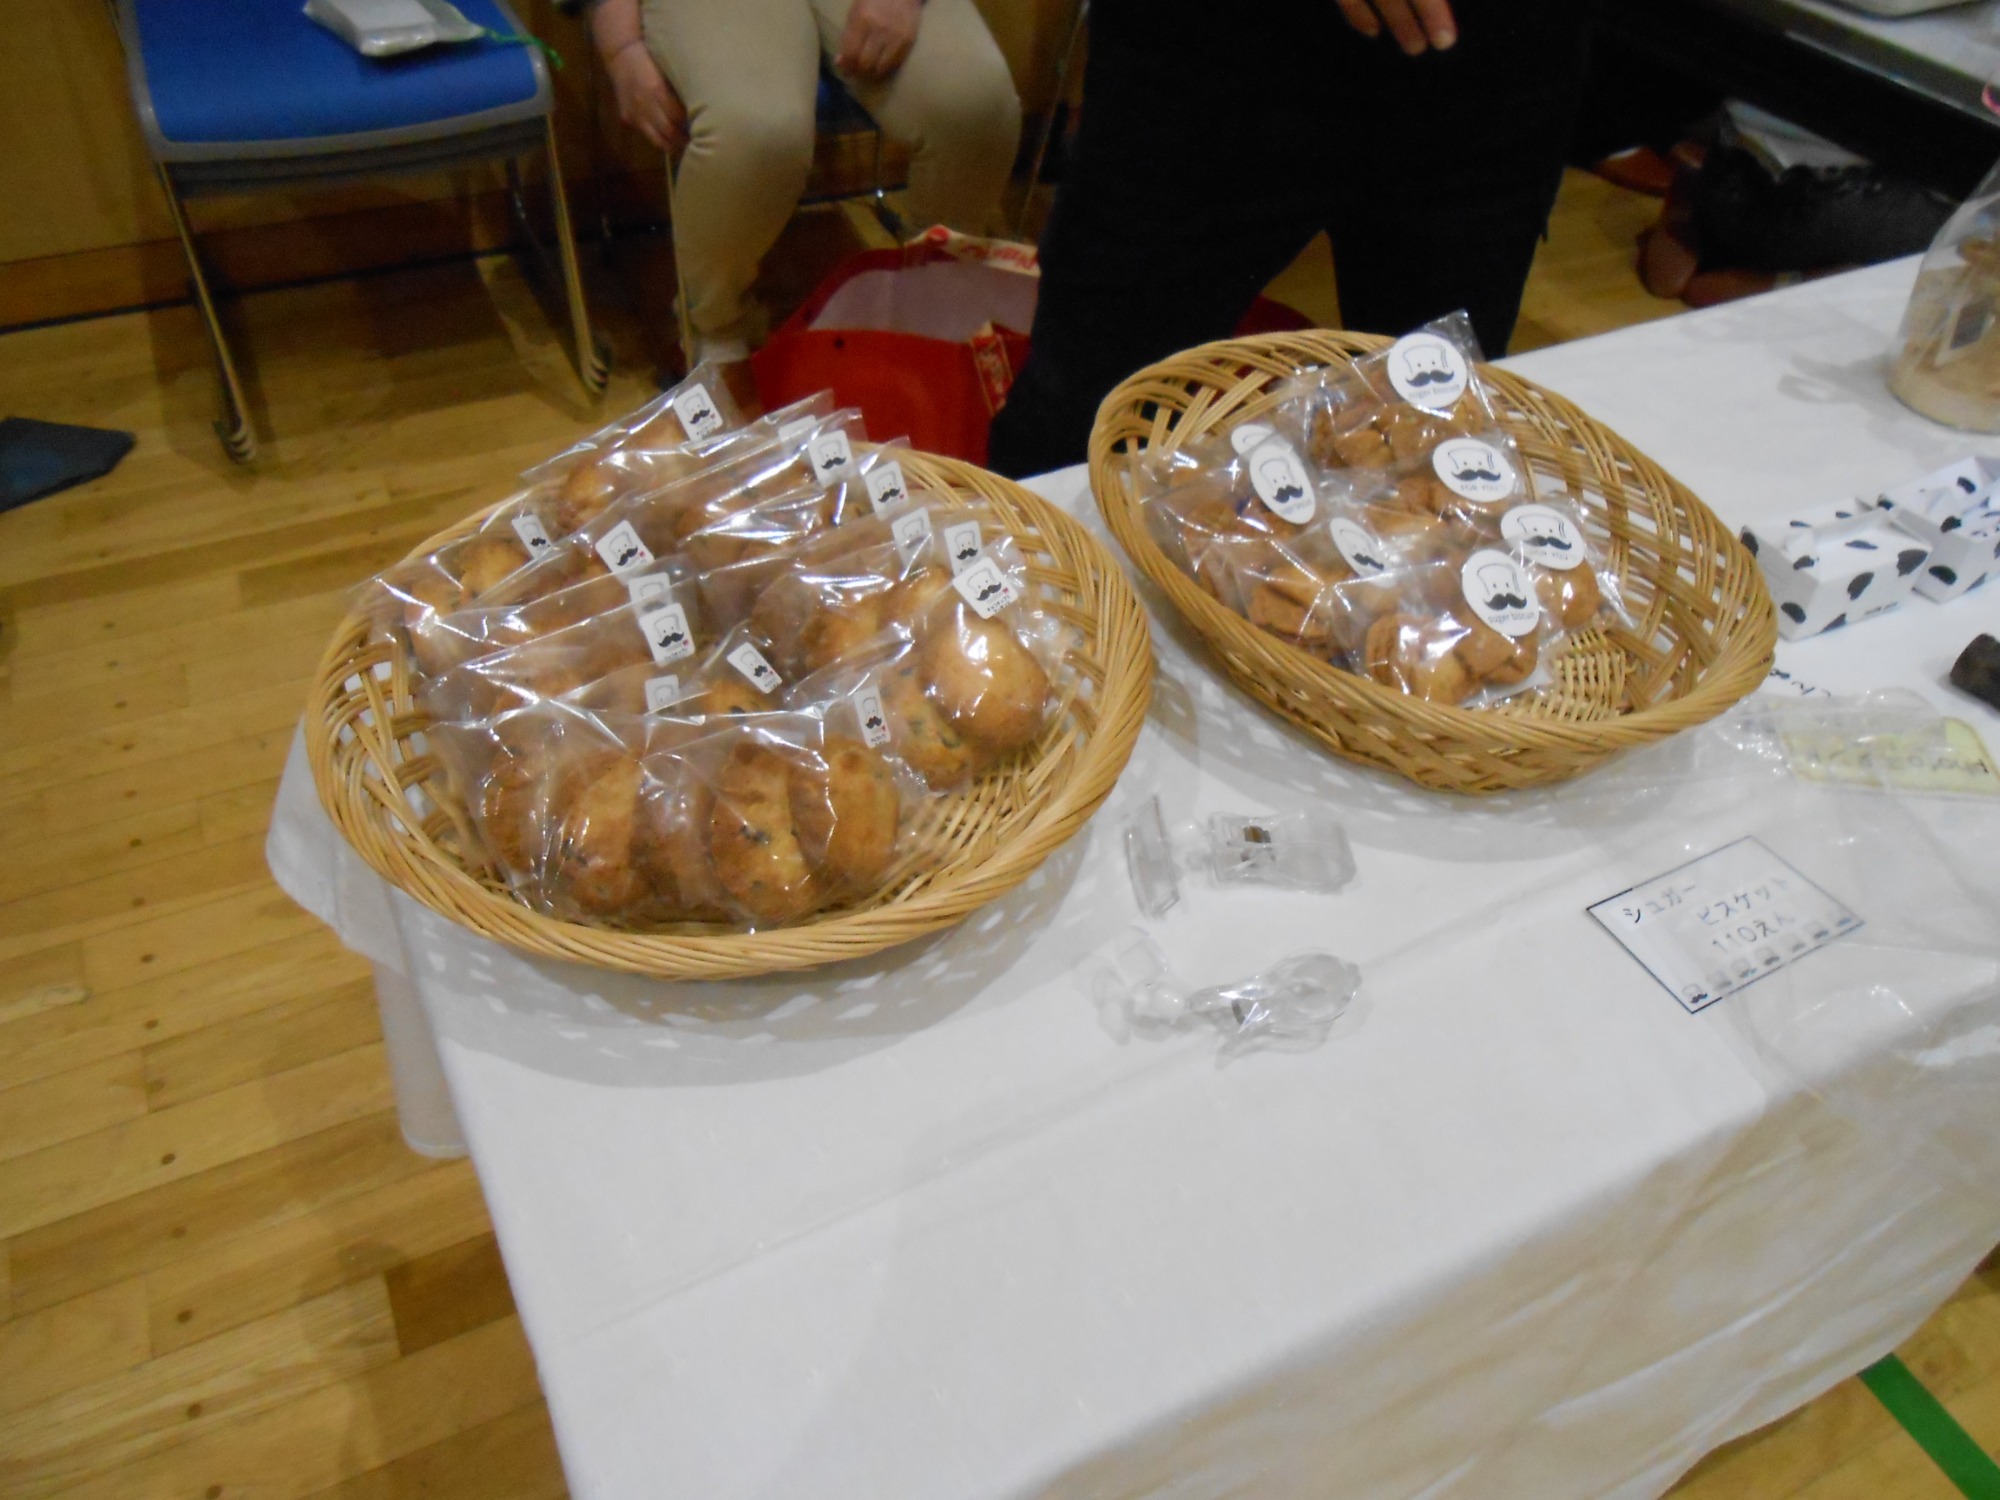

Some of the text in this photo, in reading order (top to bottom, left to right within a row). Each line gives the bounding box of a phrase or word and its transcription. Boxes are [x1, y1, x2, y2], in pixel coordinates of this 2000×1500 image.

[1622, 884, 1697, 924] シュガー
[1697, 877, 1789, 926] ビスケット
